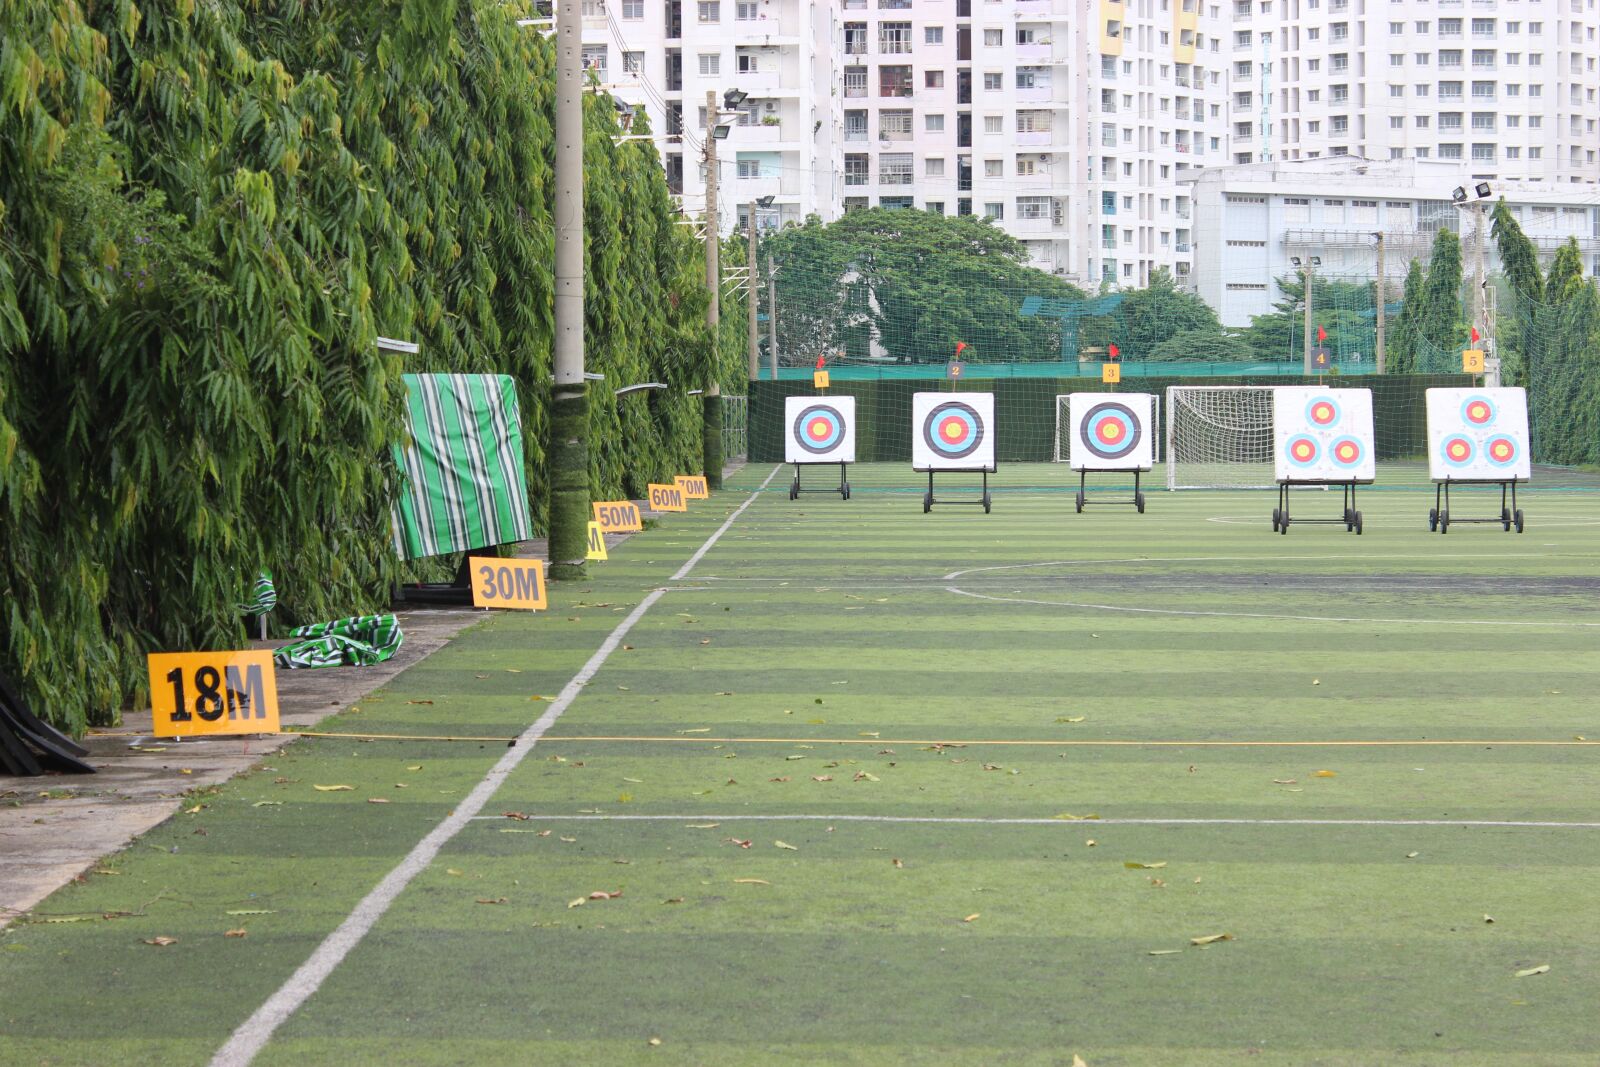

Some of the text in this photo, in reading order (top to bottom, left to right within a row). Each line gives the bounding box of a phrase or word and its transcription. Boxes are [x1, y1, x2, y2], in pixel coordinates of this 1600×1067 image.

[1316, 353, 1324, 364] 4
[1470, 356, 1478, 366] 5
[952, 366, 960, 375] 2
[1108, 368, 1114, 378] 3
[652, 488, 682, 507] 60M
[599, 505, 637, 528] 50M
[480, 565, 540, 602] 30M
[166, 663, 267, 723] 18M
